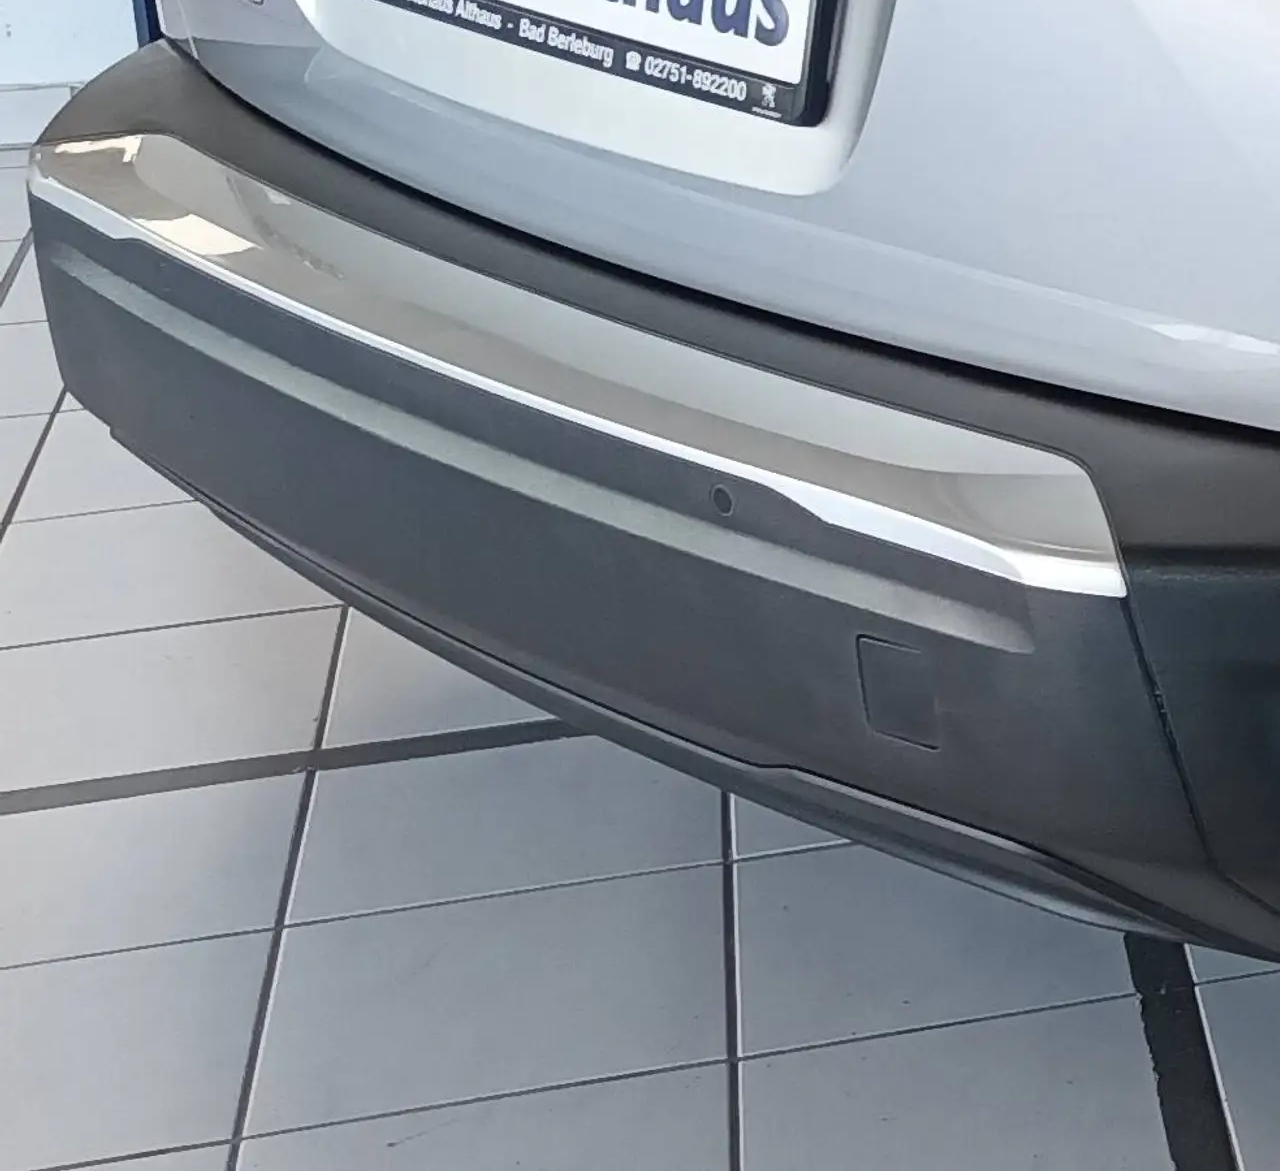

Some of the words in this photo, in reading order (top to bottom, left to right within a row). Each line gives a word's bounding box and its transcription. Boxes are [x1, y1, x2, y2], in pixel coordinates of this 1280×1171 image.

[519, 18, 546, 44] Bad
[547, 25, 614, 68] Berleburg
[644, 55, 748, 102] 02751-892200
